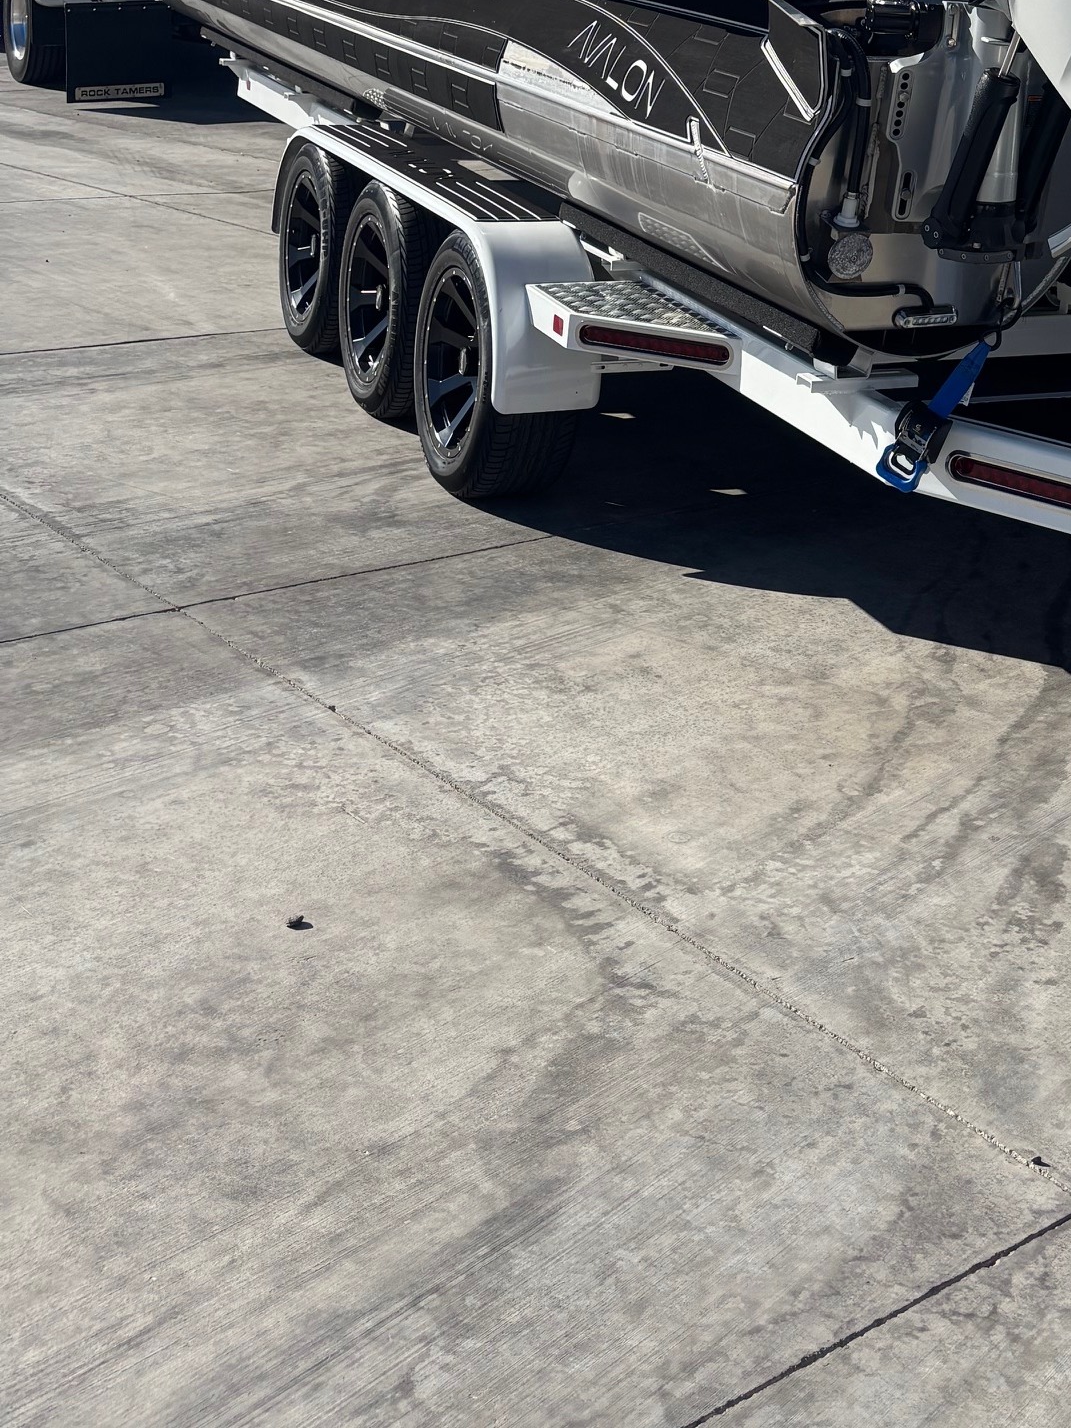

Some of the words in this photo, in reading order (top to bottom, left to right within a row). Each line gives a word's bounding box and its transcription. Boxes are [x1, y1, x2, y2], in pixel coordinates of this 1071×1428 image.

[80, 88, 111, 98] ROCK
[114, 85, 160, 96] TAMERS
[567, 19, 666, 120] AVALON
